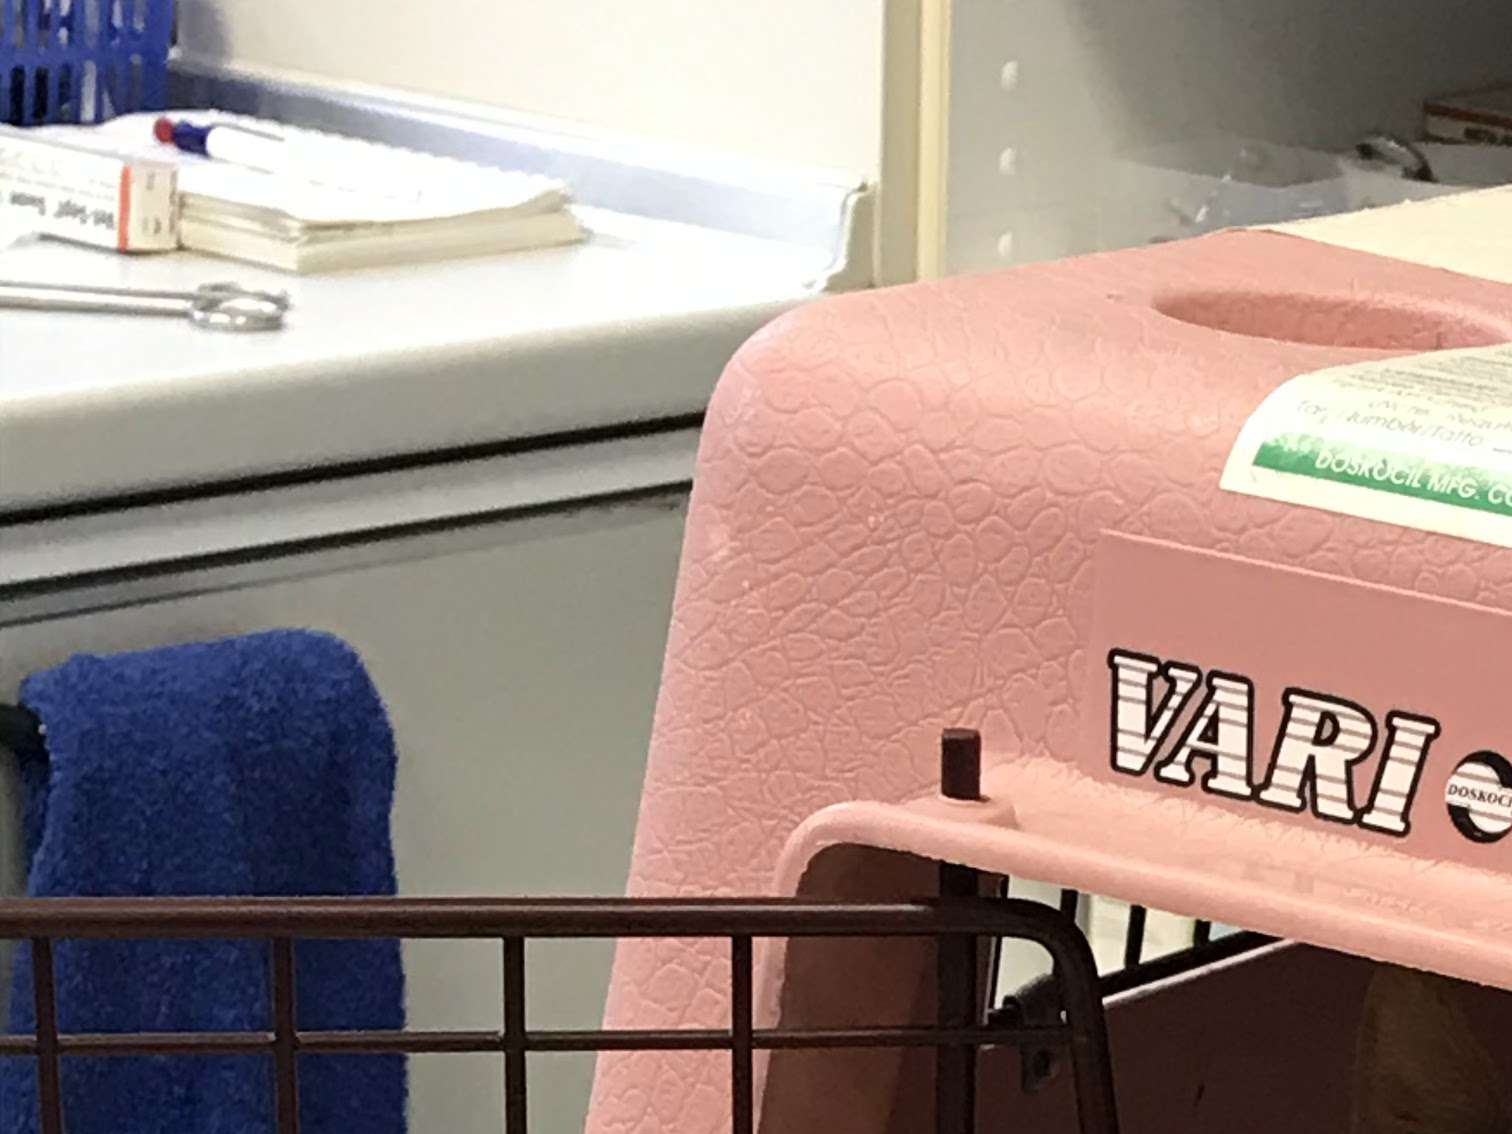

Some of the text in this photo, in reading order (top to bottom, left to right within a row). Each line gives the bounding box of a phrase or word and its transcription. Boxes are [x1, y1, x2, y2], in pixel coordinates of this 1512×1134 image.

[1313, 450, 1421, 488] DOSKOCIL
[1427, 473, 1481, 500] MFG.
[1107, 647, 1441, 837] VARI
